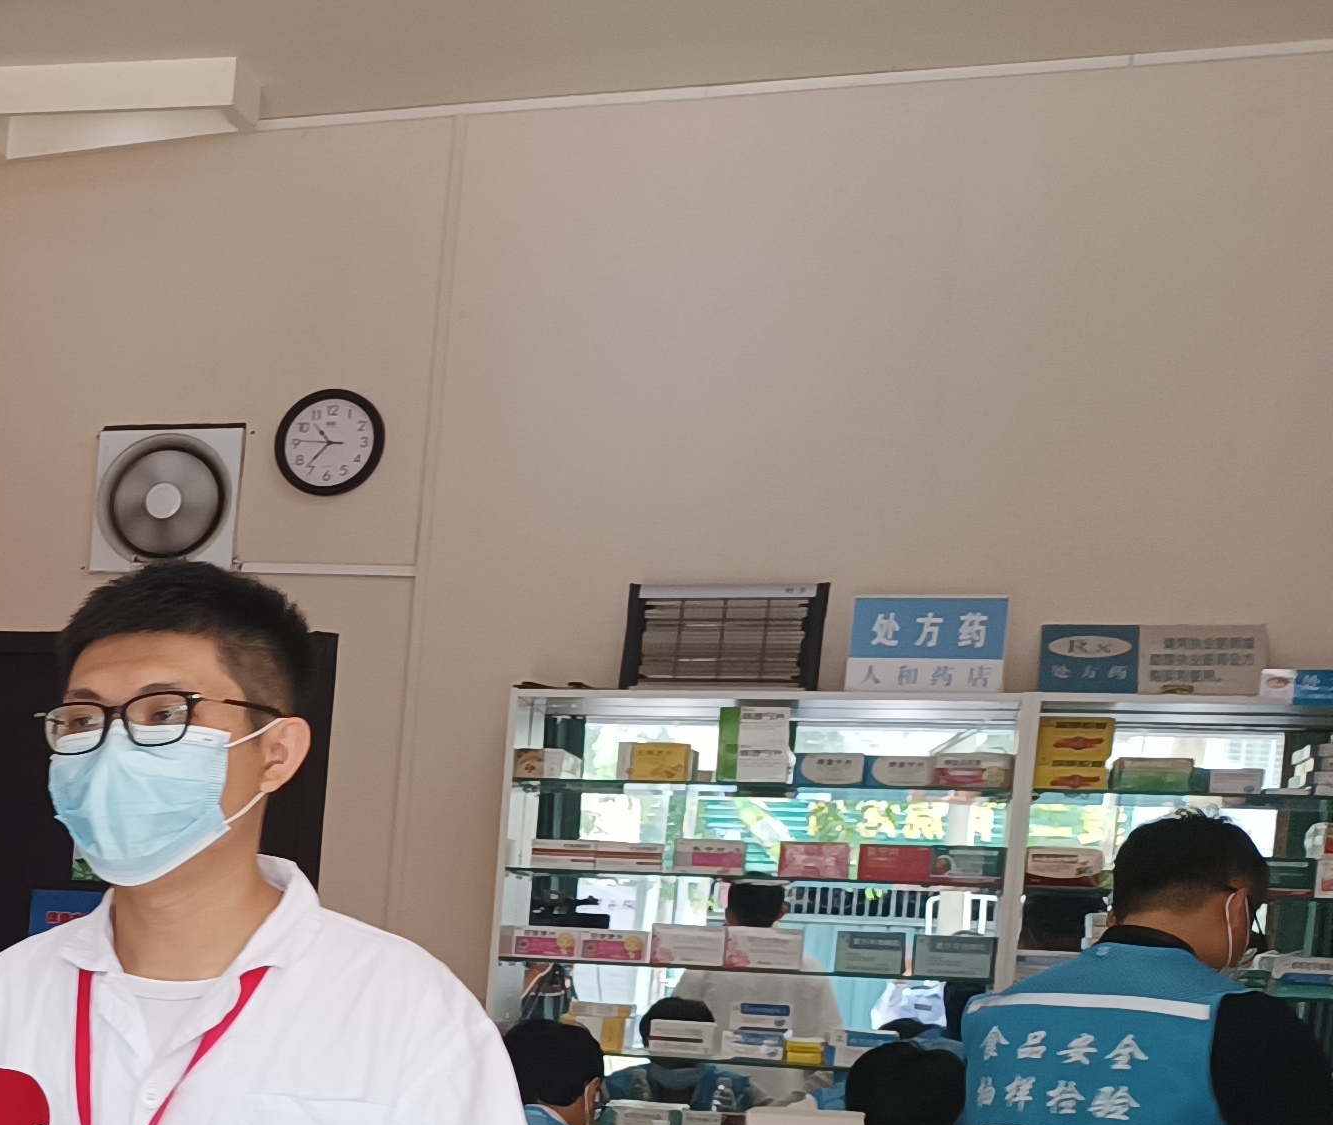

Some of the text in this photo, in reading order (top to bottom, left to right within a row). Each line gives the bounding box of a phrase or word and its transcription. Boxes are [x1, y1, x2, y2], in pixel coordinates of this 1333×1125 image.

[871, 611, 989, 649] 处方药
[861, 663, 993, 689] 人和药店
[1050, 664, 1128, 680] 处方药
[979, 1025, 1149, 1070] 食品安全
[976, 1074, 1141, 1121] 抽样检验
